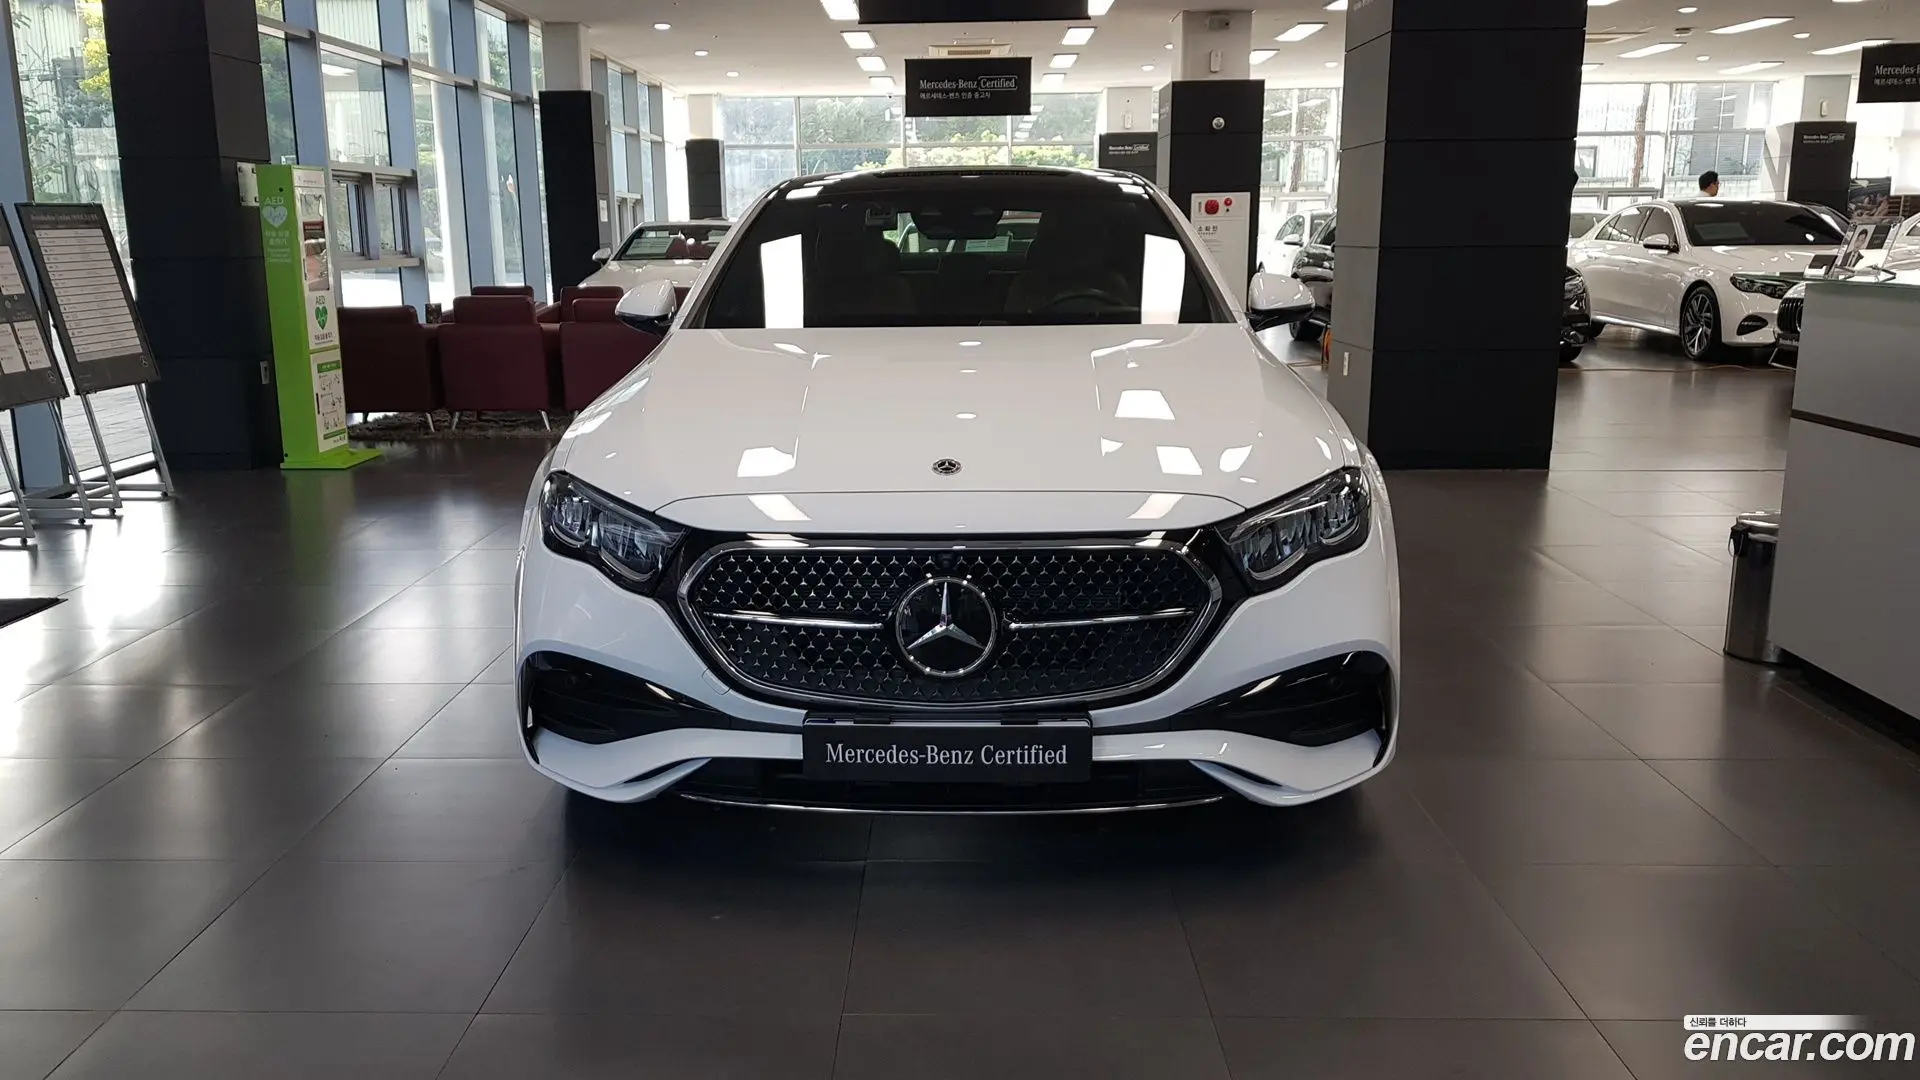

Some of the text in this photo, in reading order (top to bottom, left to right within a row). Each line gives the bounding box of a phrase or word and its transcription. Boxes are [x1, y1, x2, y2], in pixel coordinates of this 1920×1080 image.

[920, 78, 1015, 89] Mercedes-Benz Certified
[264, 196, 284, 205] AED
[825, 743, 1068, 766] Mercedes-Benz Certified
